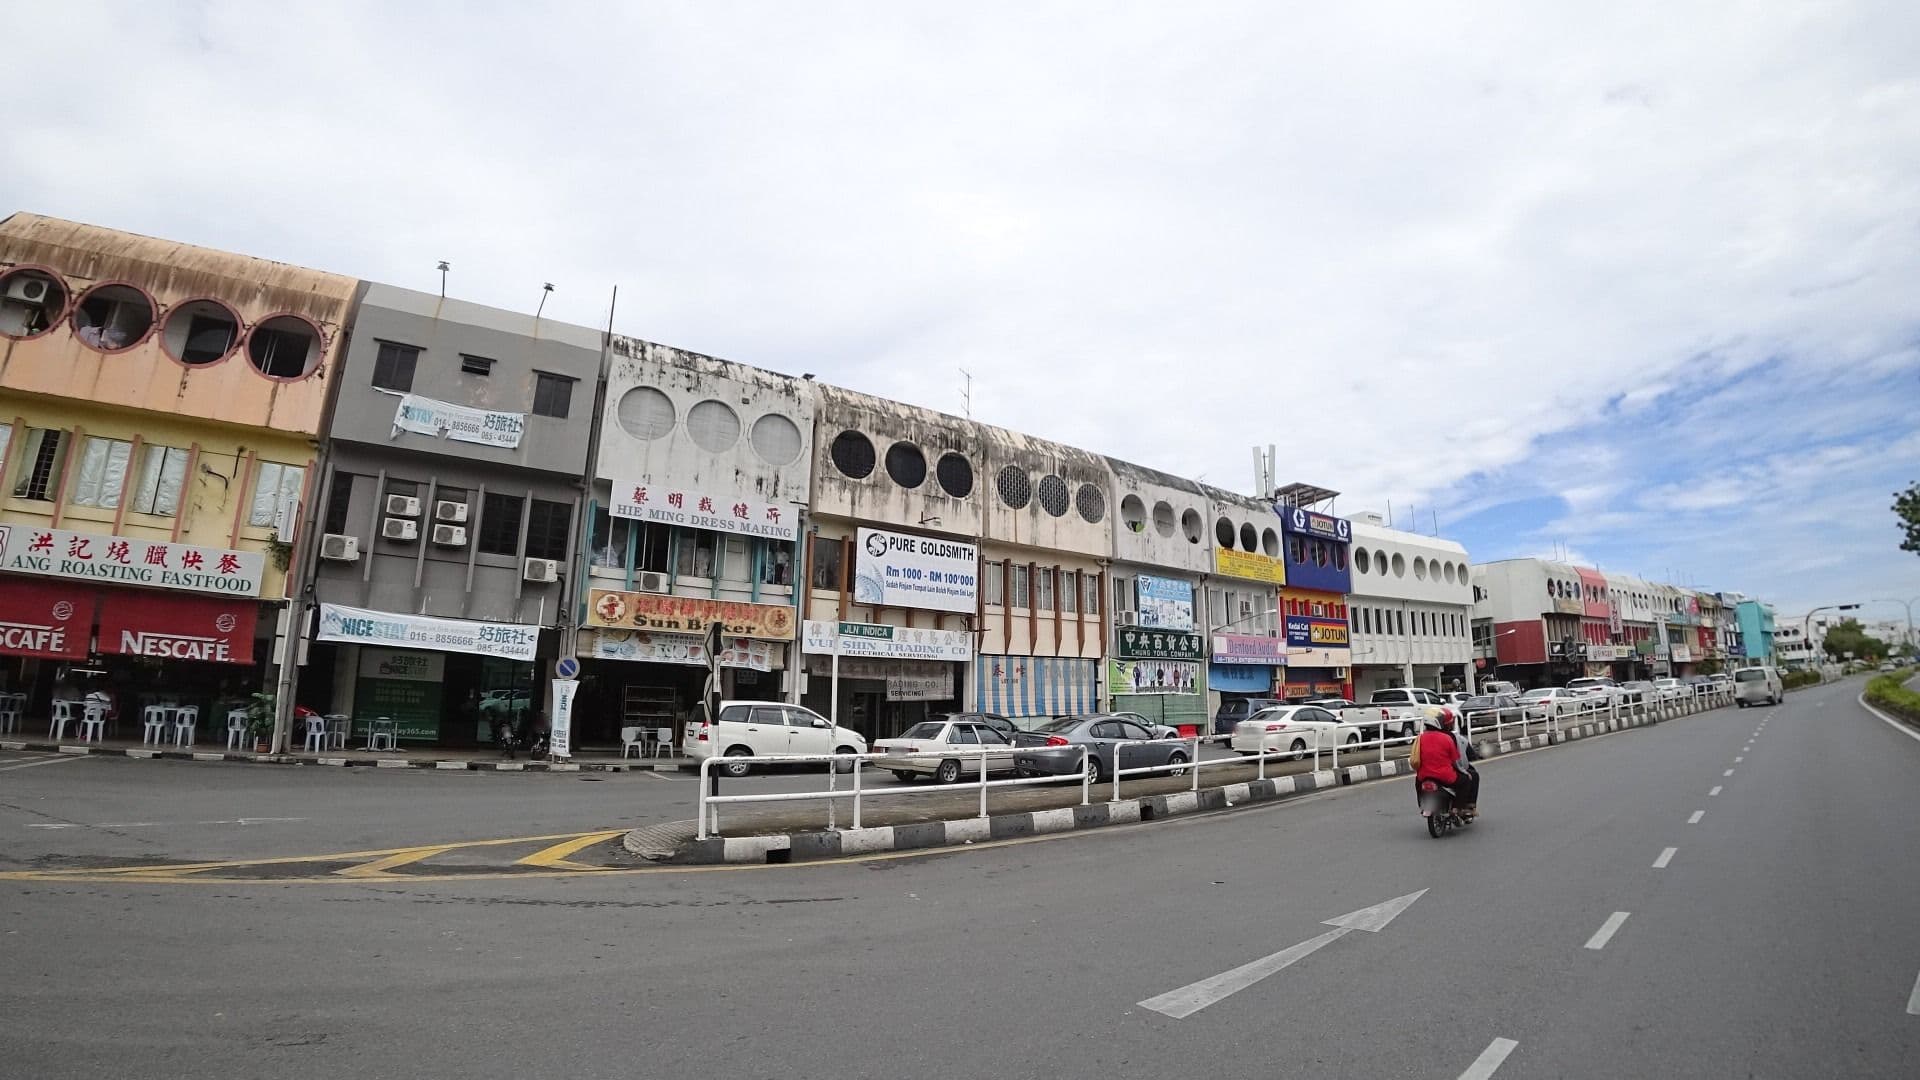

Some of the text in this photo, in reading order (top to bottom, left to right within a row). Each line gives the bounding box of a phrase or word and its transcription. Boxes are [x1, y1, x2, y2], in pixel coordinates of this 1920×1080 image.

[483, 414, 519, 433] 好旅社
[616, 504, 792, 538] HIE MING DRESS MAKING
[889, 536, 974, 561] PURE GOLDSMITH
[10, 555, 252, 593] ANG ROASTING FASTFOOD
[886, 565, 900, 578] Rm
[902, 567, 922, 580] 1000
[929, 571, 942, 582] RM
[633, 614, 680, 629] Sun
[410, 631, 427, 642] 016
[435, 634, 473, 646] 8856666
[479, 626, 526, 646] 好旅社
[844, 624, 888, 637] JLN INDICA
[1321, 628, 1346, 640] JOTUN
[119, 630, 230, 662] NESCAFÉ
[476, 643, 492, 653] 085
[843, 640, 877, 650] SHIN
[886, 644, 944, 654] TRADING
[1125, 632, 1199, 652] 中央百貨公司
[1153, 649, 1168, 657] YONG
[1171, 650, 1195, 658] COMPANY
